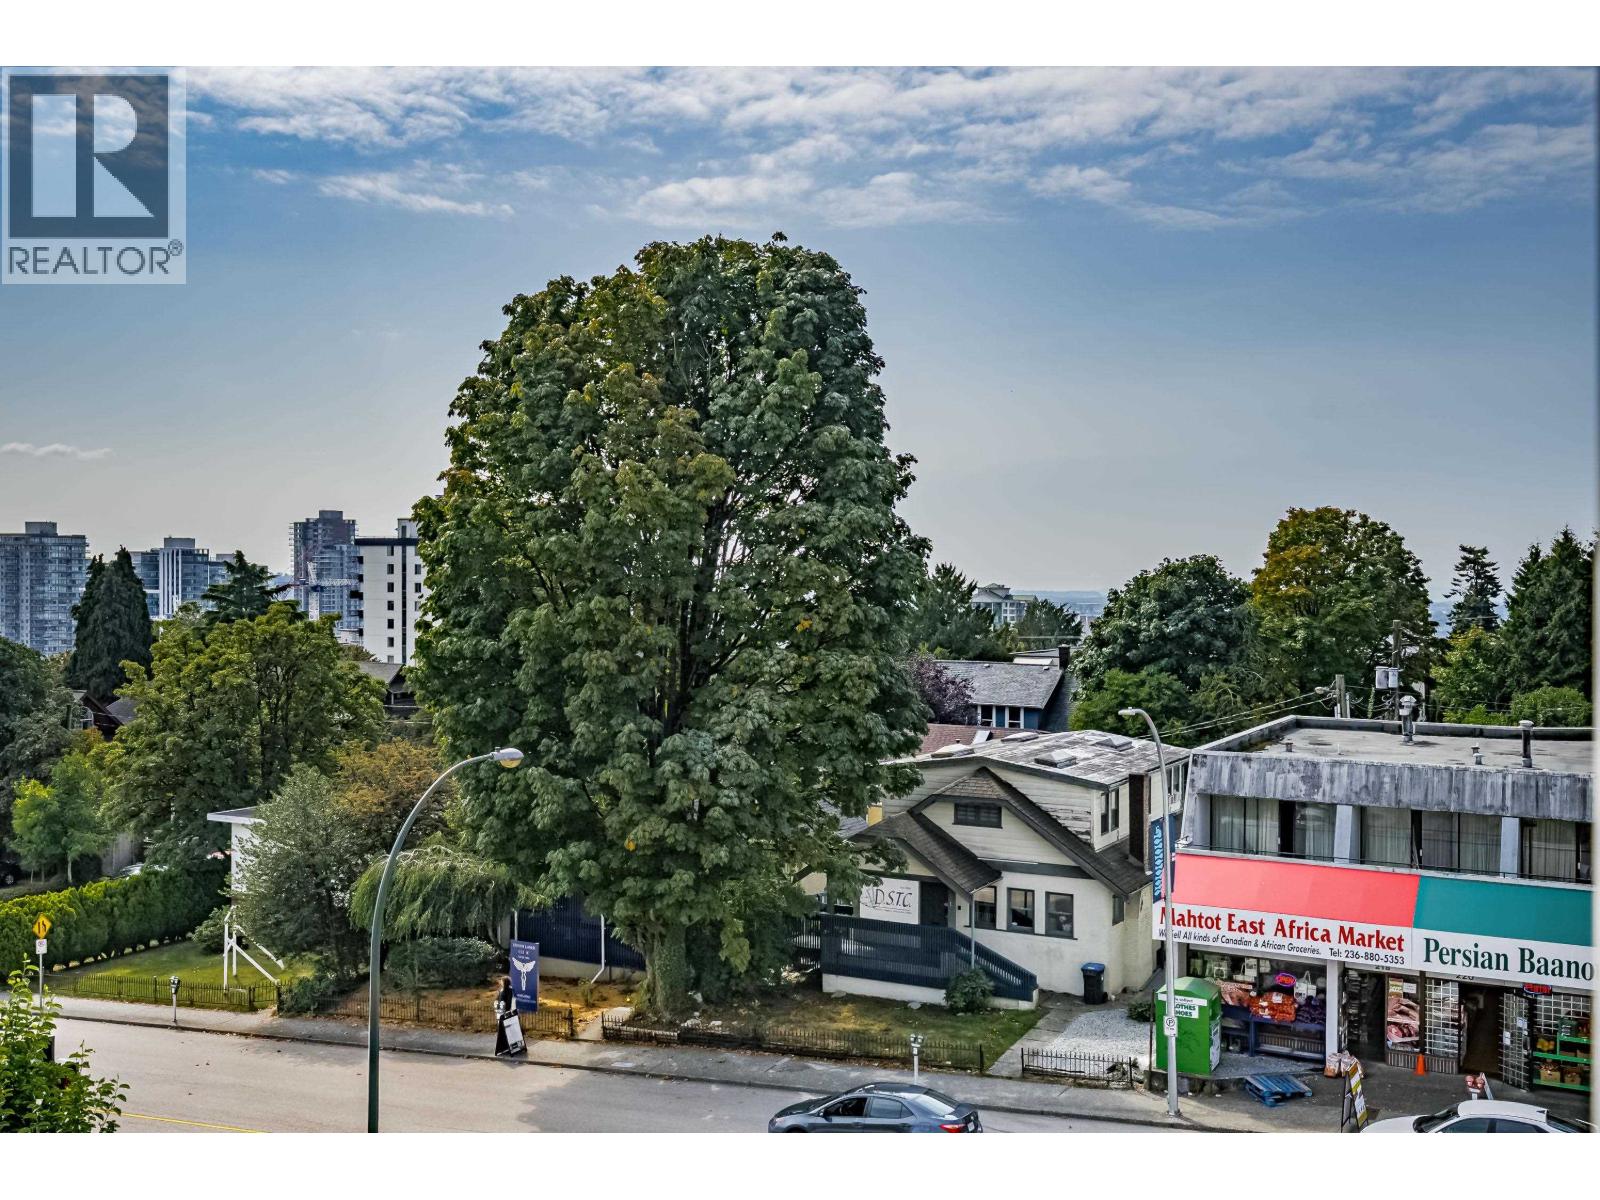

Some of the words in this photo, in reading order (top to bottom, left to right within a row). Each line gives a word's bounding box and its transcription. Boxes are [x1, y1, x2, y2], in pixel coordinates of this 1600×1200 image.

[1172, 930, 1182, 939] ell
[1182, 931, 1192, 941] All
[1193, 932, 1210, 943] kinds
[1212, 934, 1219, 943] of
[1221, 935, 1252, 947] Canadian
[1254, 939, 1259, 948] &
[1261, 940, 1286, 950] African
[1287, 942, 1322, 955] Groceries.
[1329, 947, 1342, 958] Tel:
[1344, 949, 1405, 965] 236-880-5353
[1228, 913, 1265, 935] East
[1274, 918, 1331, 943] Africa
[1338, 925, 1405, 952] Market
[1423, 937, 1509, 972] Persian
[1175, 1003, 1196, 1011] OTHES
